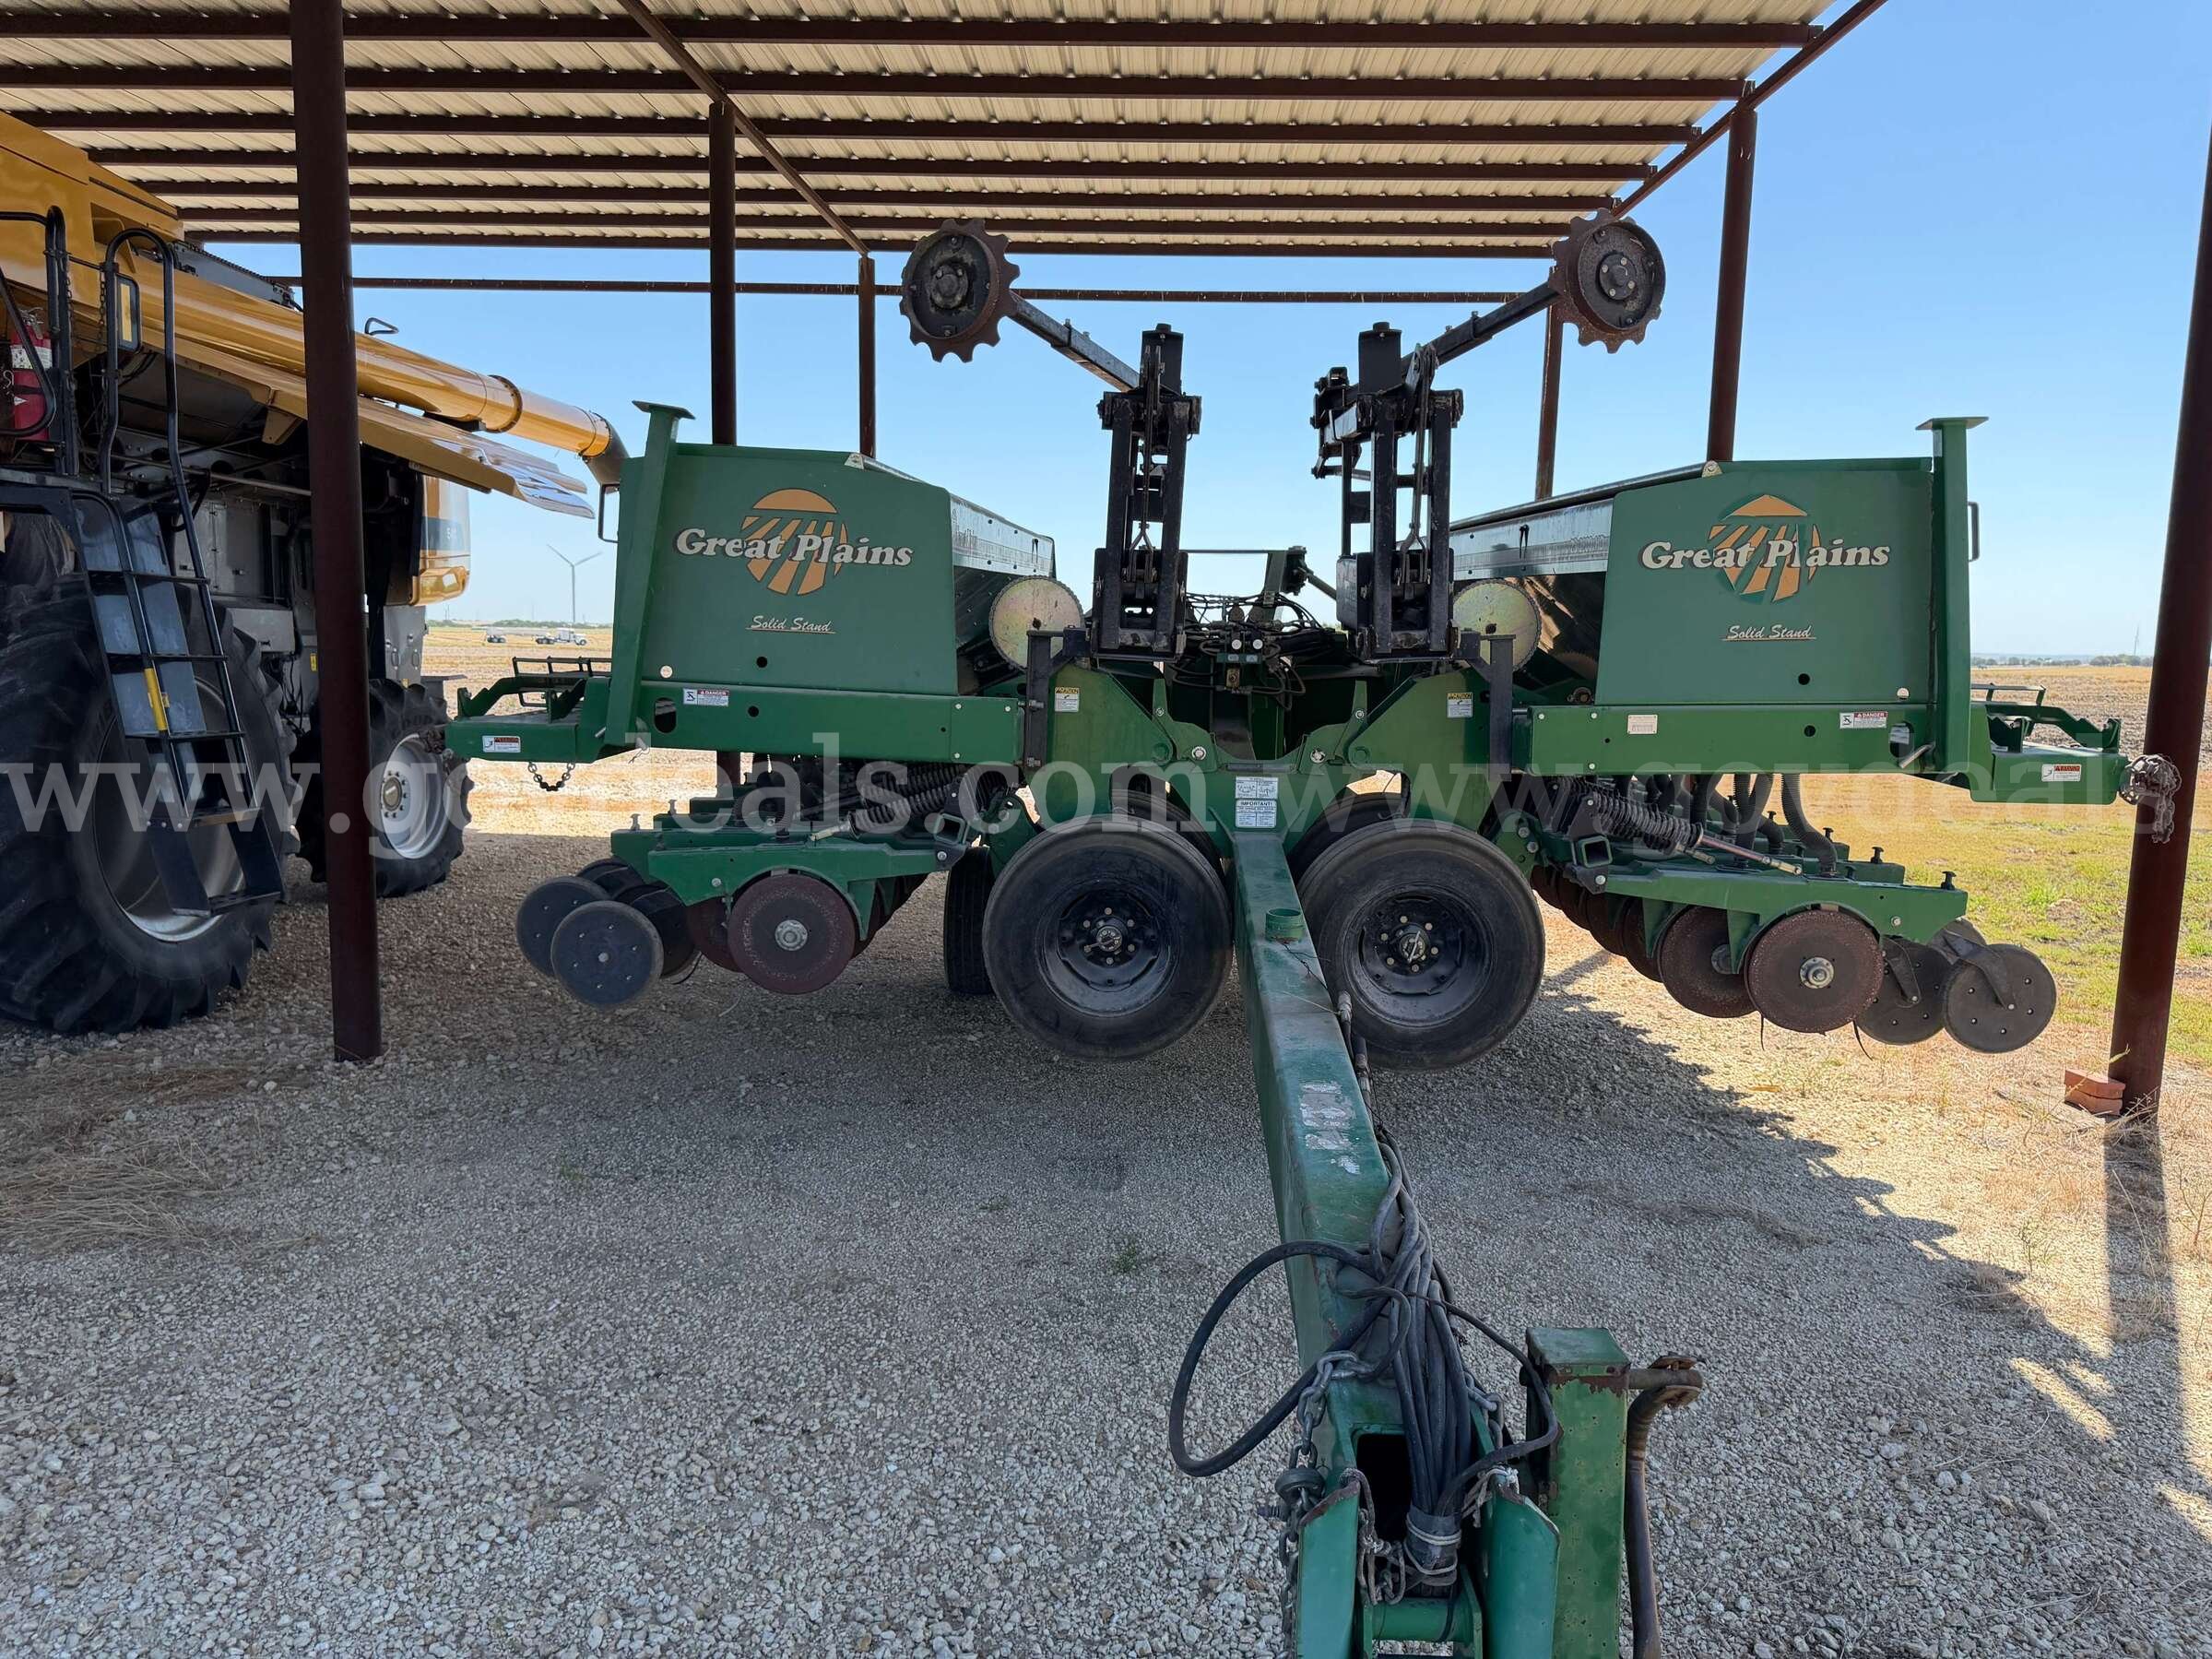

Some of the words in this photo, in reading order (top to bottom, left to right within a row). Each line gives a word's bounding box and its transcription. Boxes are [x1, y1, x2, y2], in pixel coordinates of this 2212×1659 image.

[677, 527, 785, 561] Great
[789, 534, 914, 566] Plains
[1641, 541, 1757, 569] Great
[1763, 539, 1890, 567] Plains
[751, 615, 787, 630] Solid
[790, 617, 832, 632] Stand
[1726, 625, 1766, 639] Solid
[1768, 624, 1812, 638] Stand
